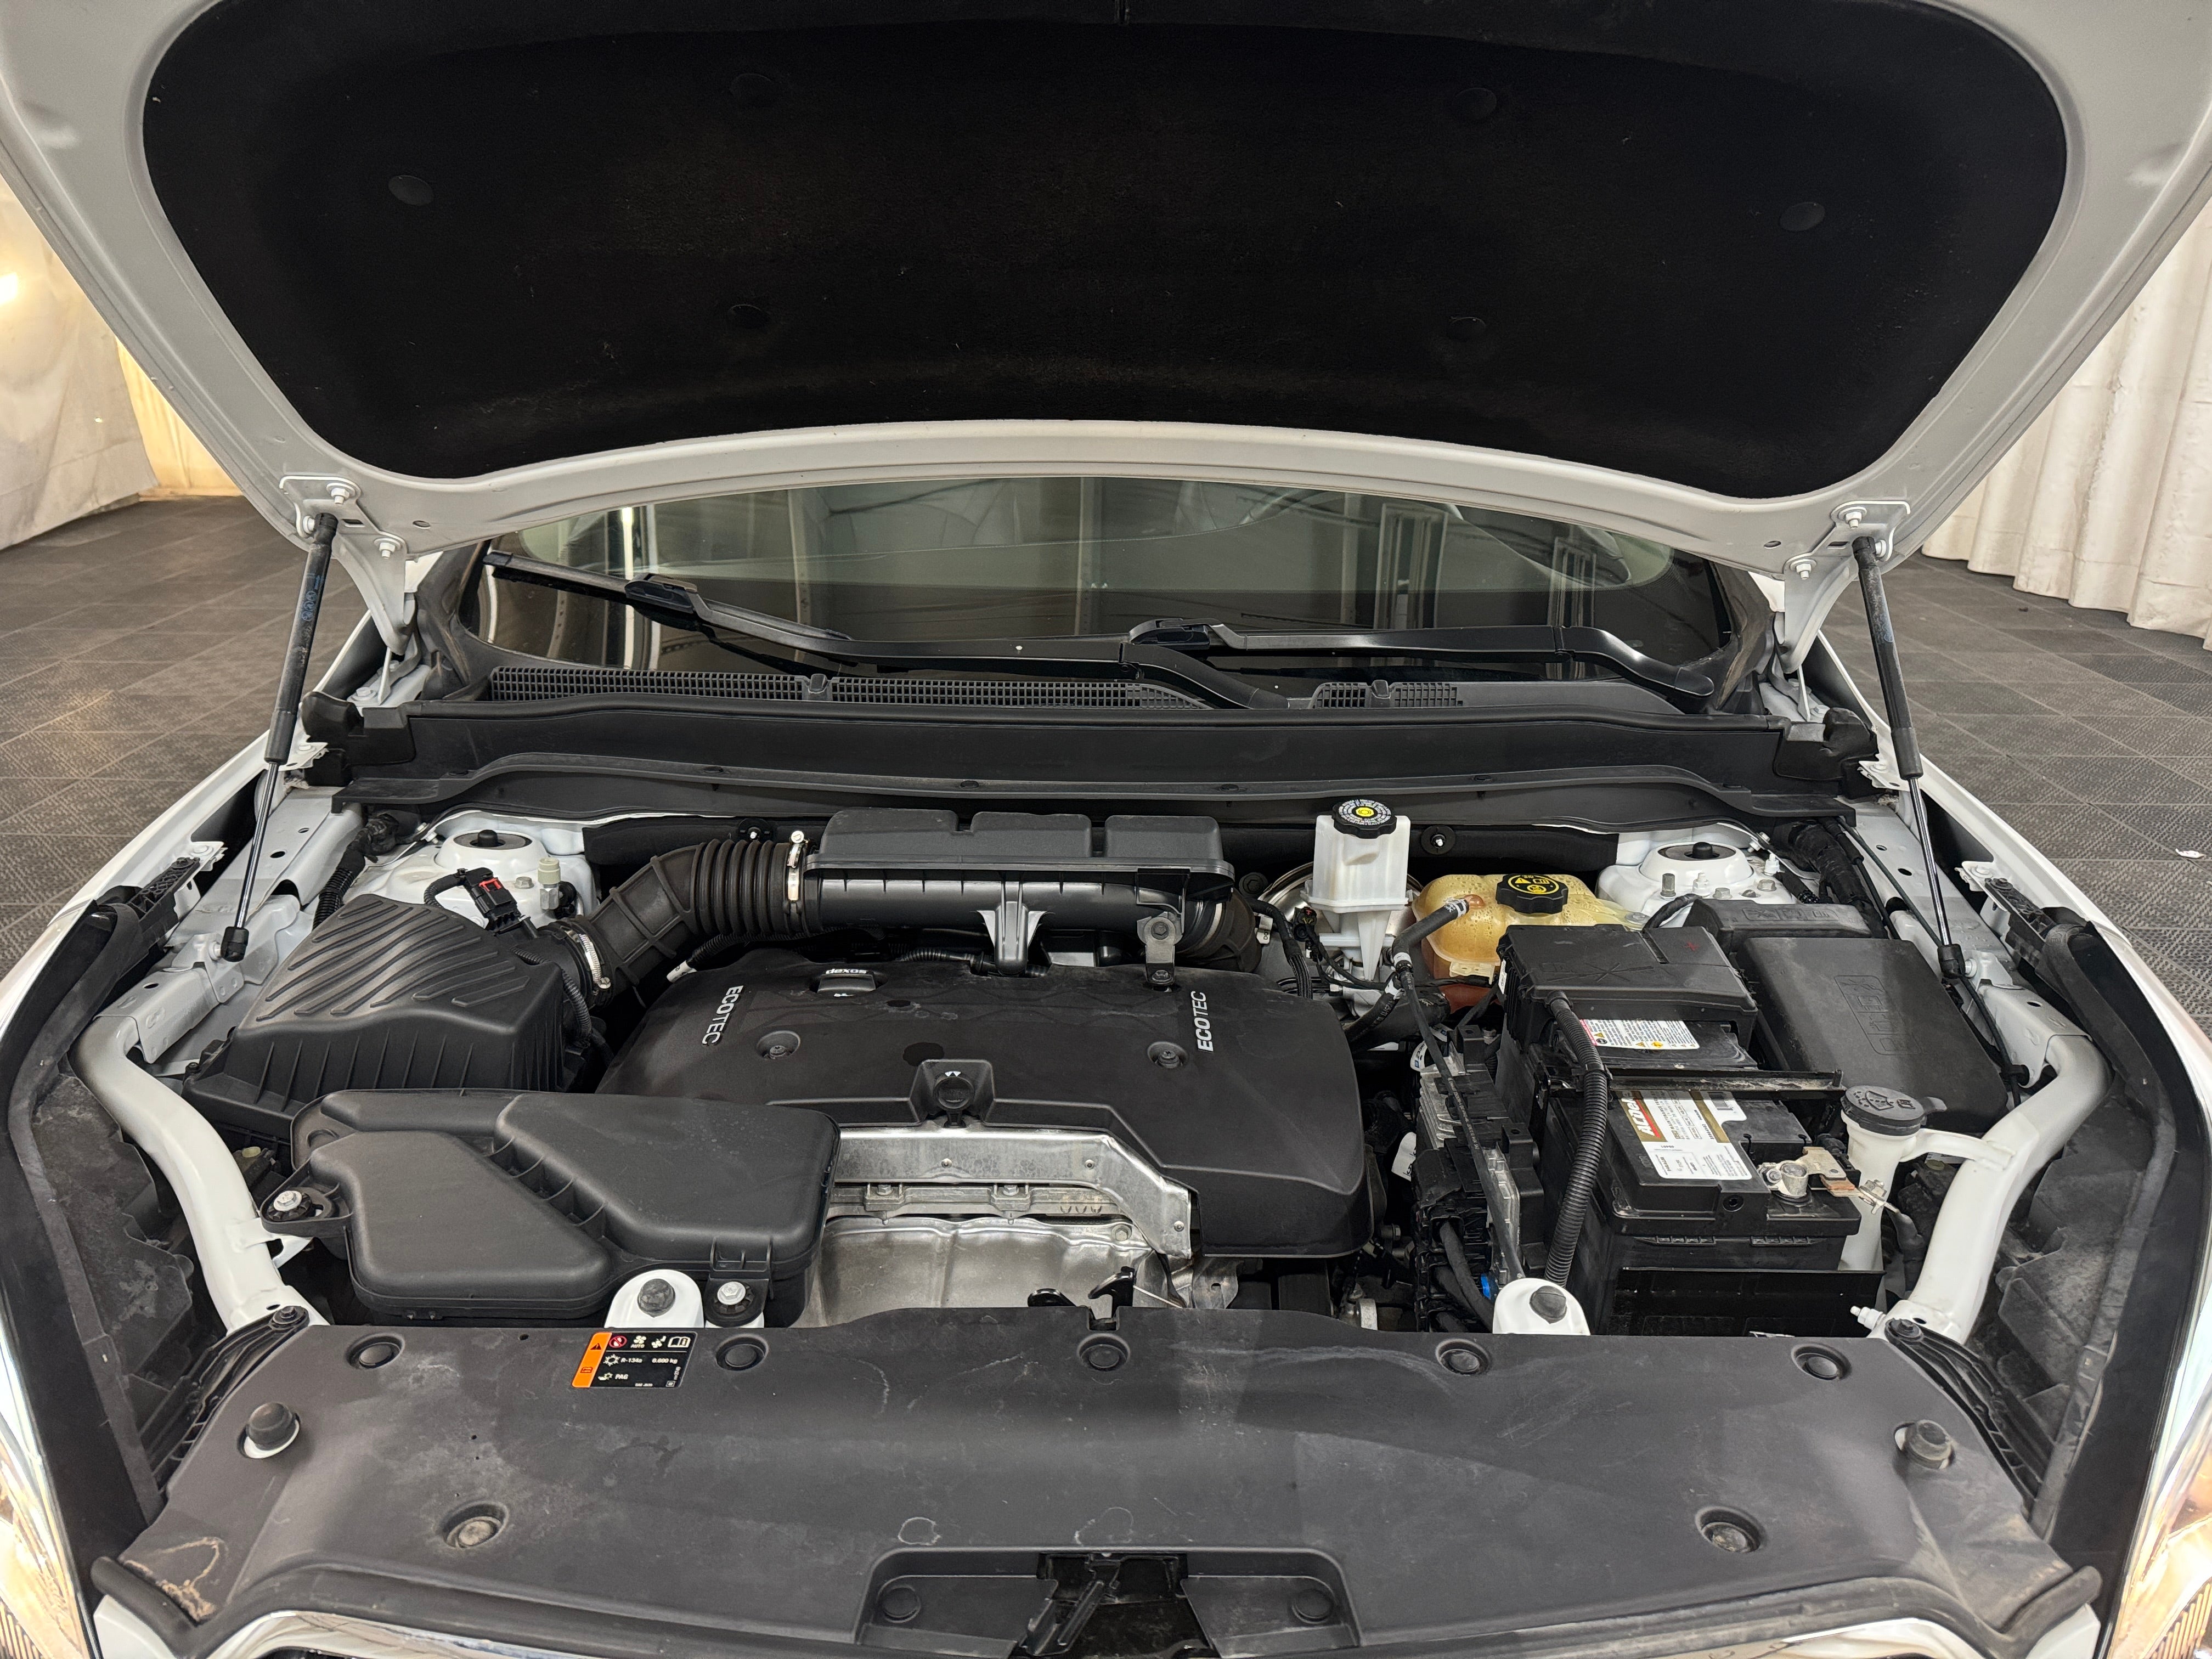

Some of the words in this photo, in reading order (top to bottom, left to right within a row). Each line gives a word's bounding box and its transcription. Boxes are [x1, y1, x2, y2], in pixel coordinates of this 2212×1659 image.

[702, 985, 744, 1045] ECOTEC
[1190, 991, 1214, 1052] ECOTEC
[1621, 1098, 1655, 1136] ACDel
